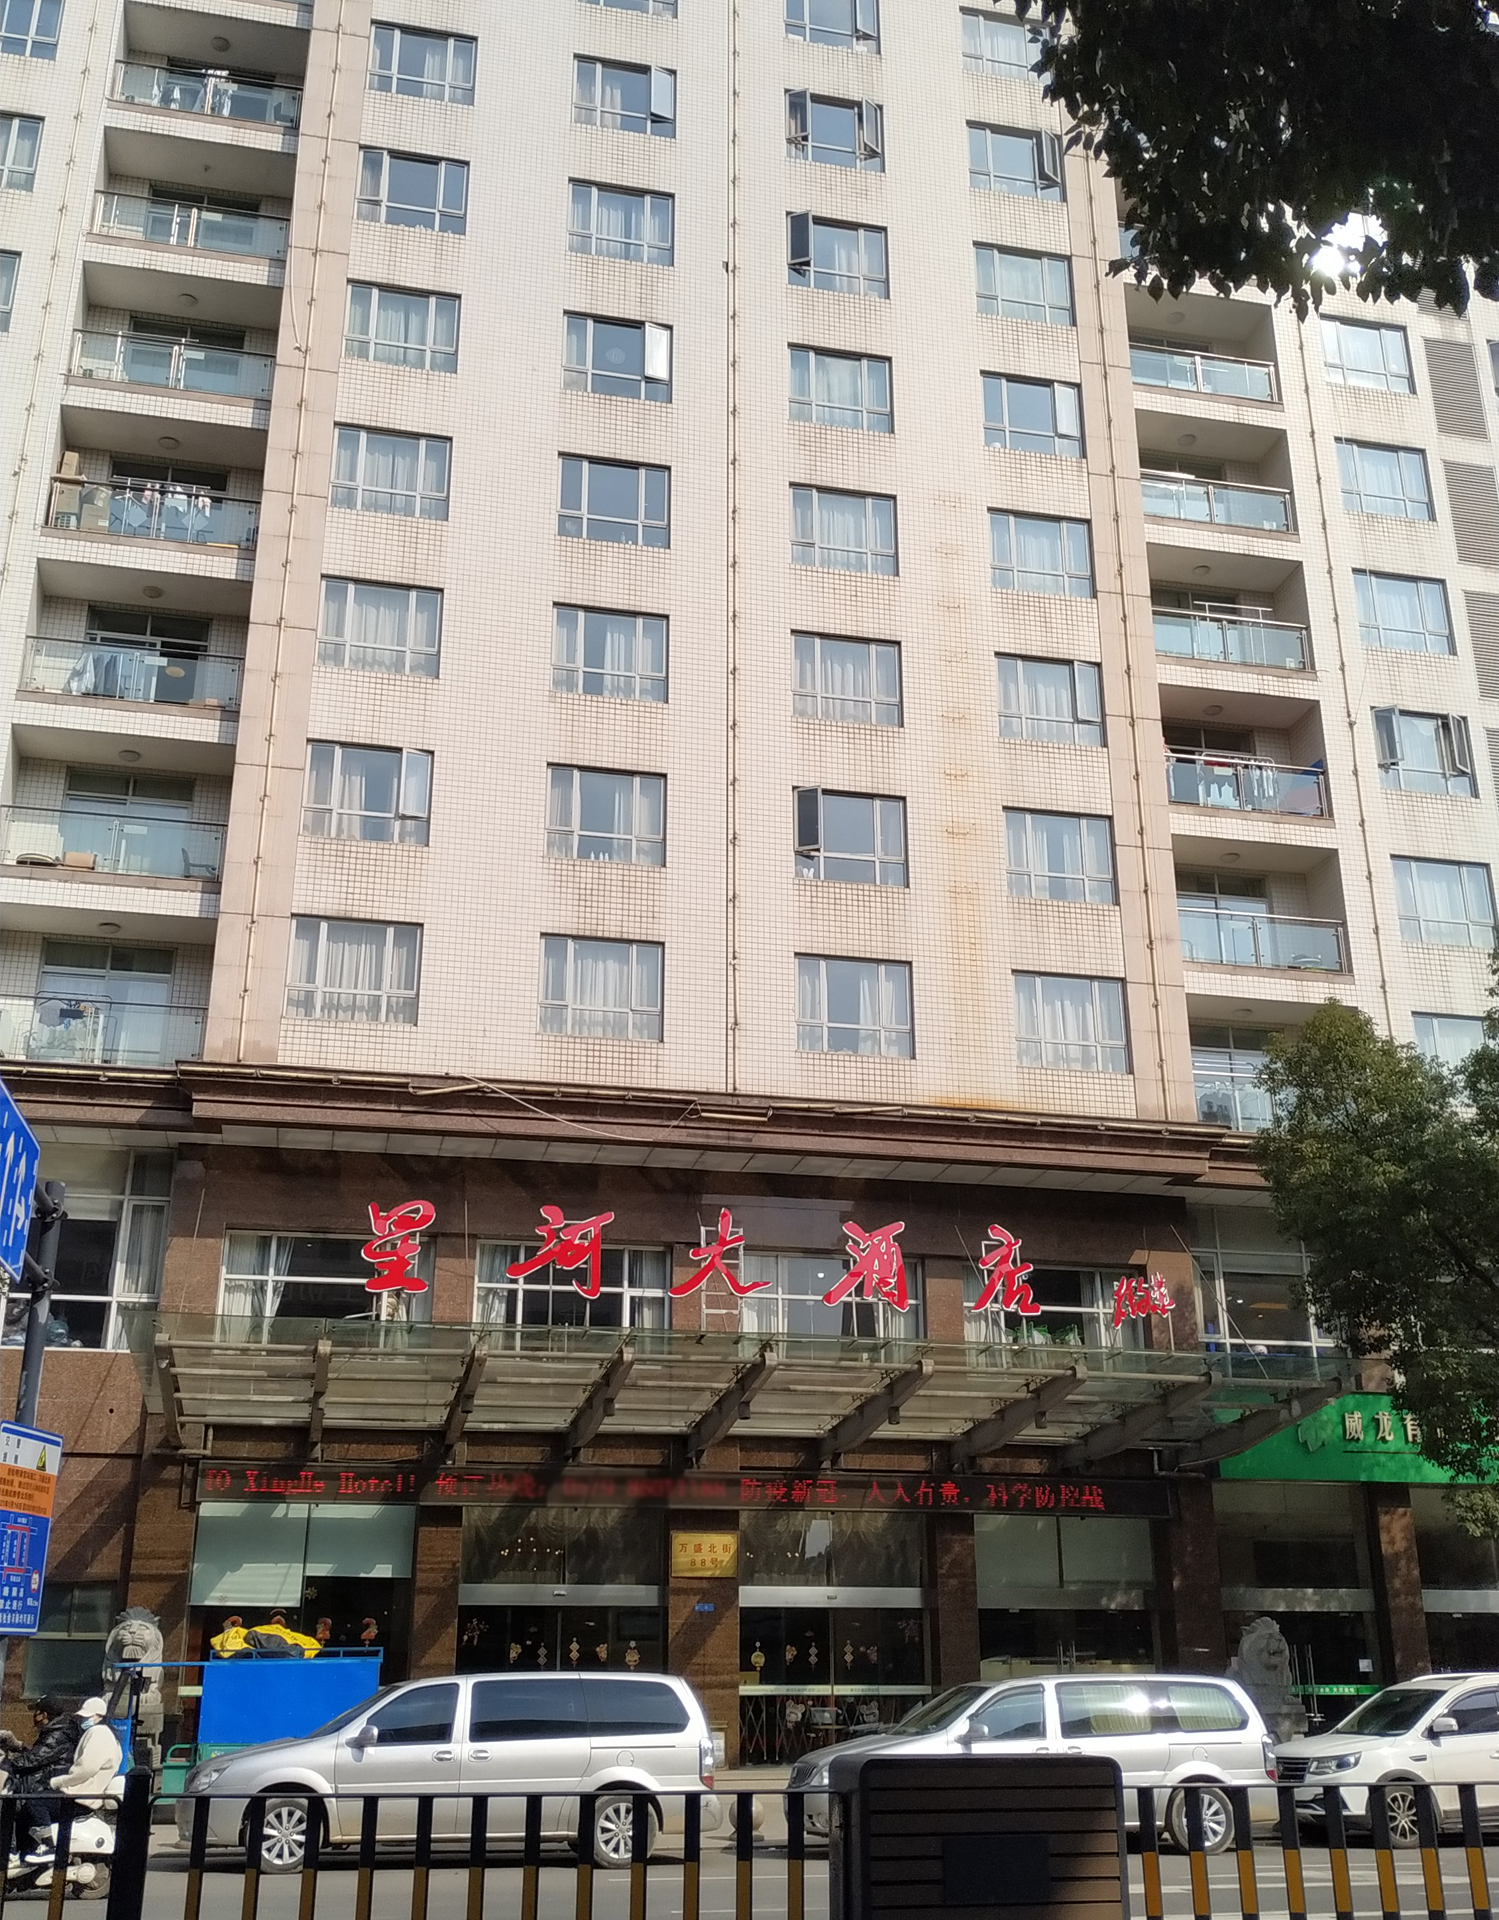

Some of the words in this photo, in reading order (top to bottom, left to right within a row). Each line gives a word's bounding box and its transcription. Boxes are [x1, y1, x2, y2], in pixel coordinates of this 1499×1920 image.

[361, 1200, 1041, 1317] 星河大酒店
[679, 1543, 732, 1553] 万盛北街
[690, 1557, 718, 1568] 88号
